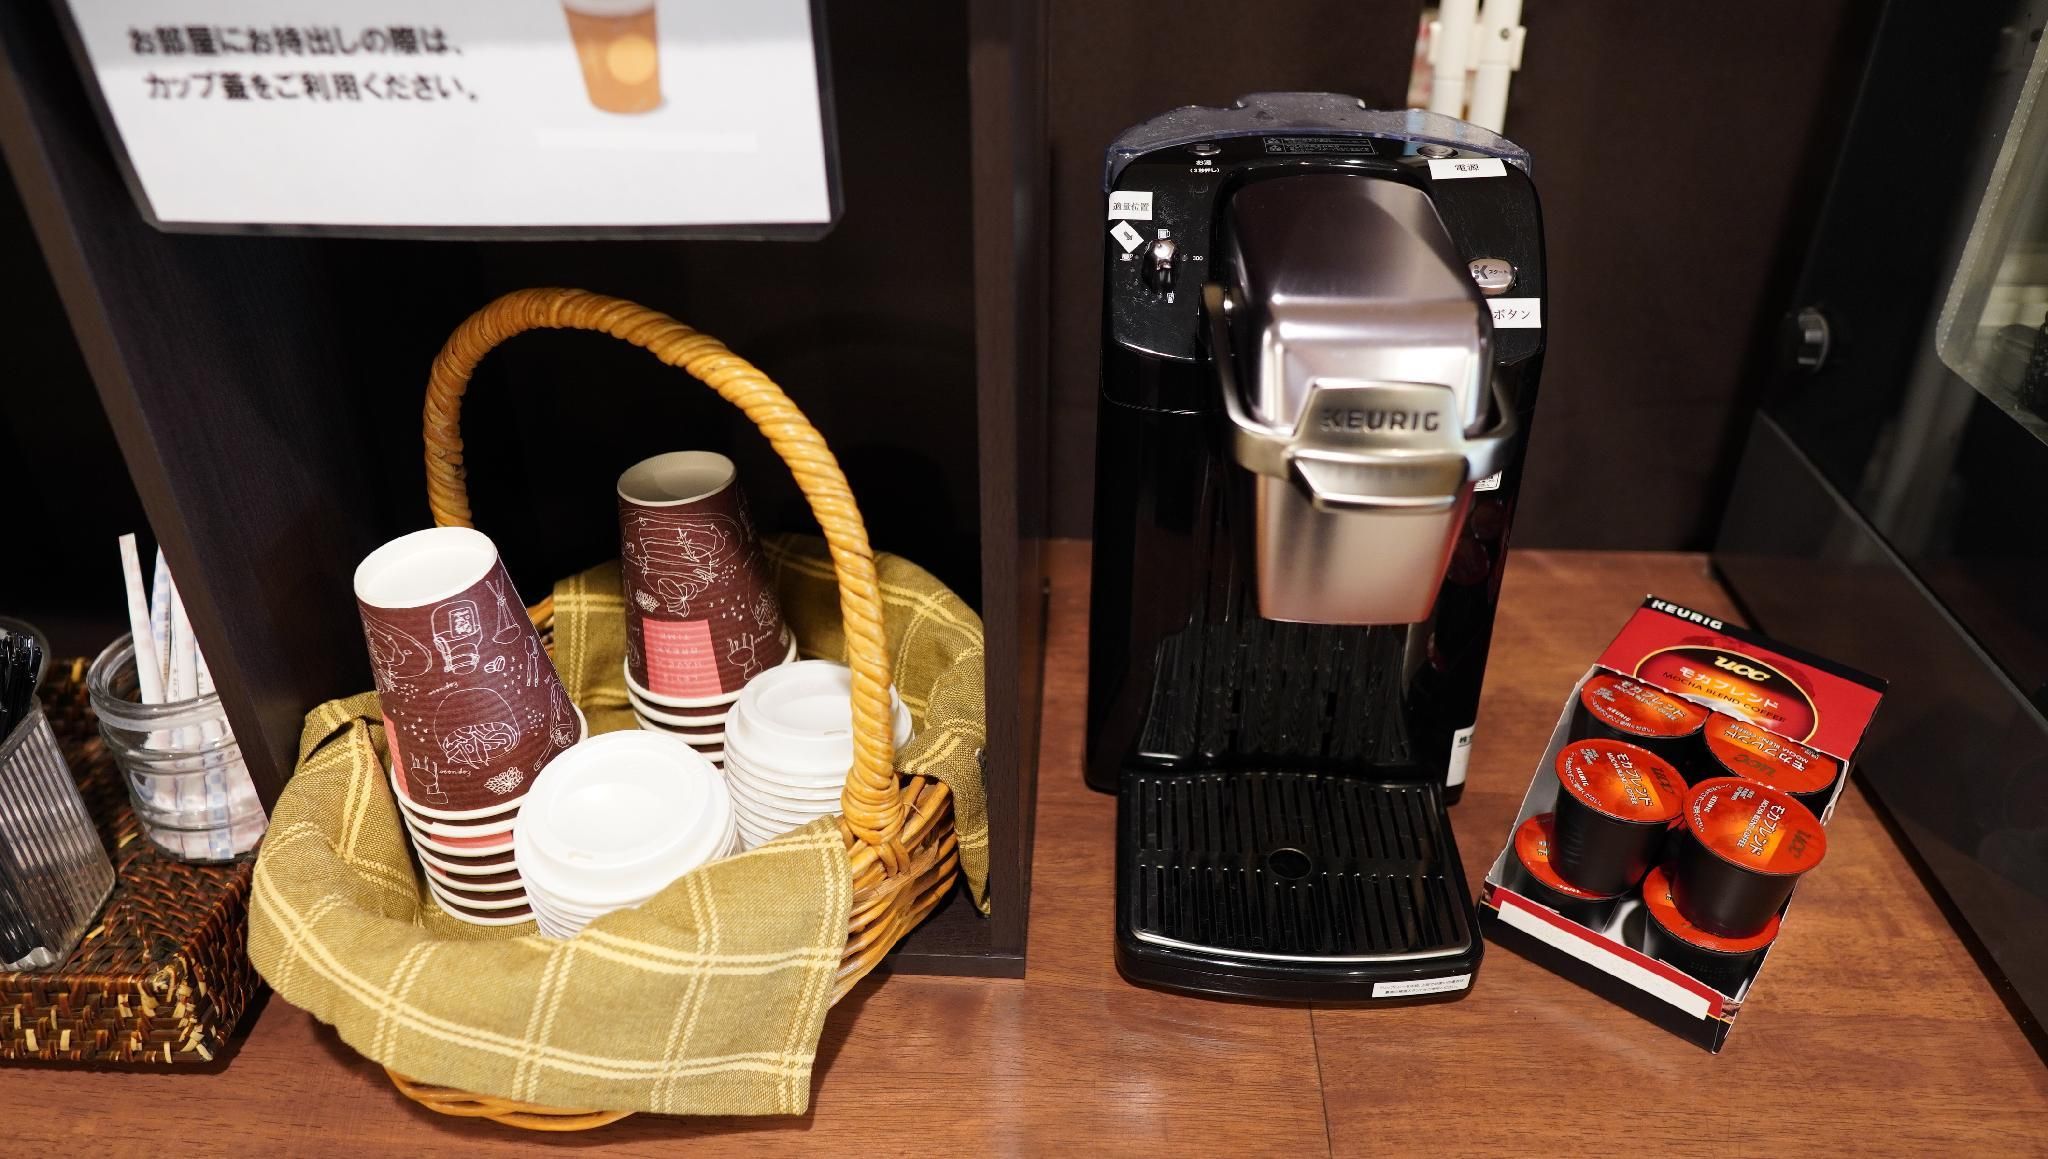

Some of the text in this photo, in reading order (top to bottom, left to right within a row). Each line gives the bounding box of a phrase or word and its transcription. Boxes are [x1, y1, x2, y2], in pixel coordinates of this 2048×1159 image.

[128, 25, 464, 56] お部屋にお持出しの際は、
[143, 72, 479, 101] カップ蓋をご利用ください。
[1493, 308, 1531, 320] ボタン
[1322, 408, 1440, 432] KEURIG
[1651, 599, 1724, 631] KEURIG
[1663, 671, 1786, 723] MOCHA BLEND COFFEE
[1607, 706, 1632, 722] KEURIG
[1782, 747, 1809, 764] MOCHA
